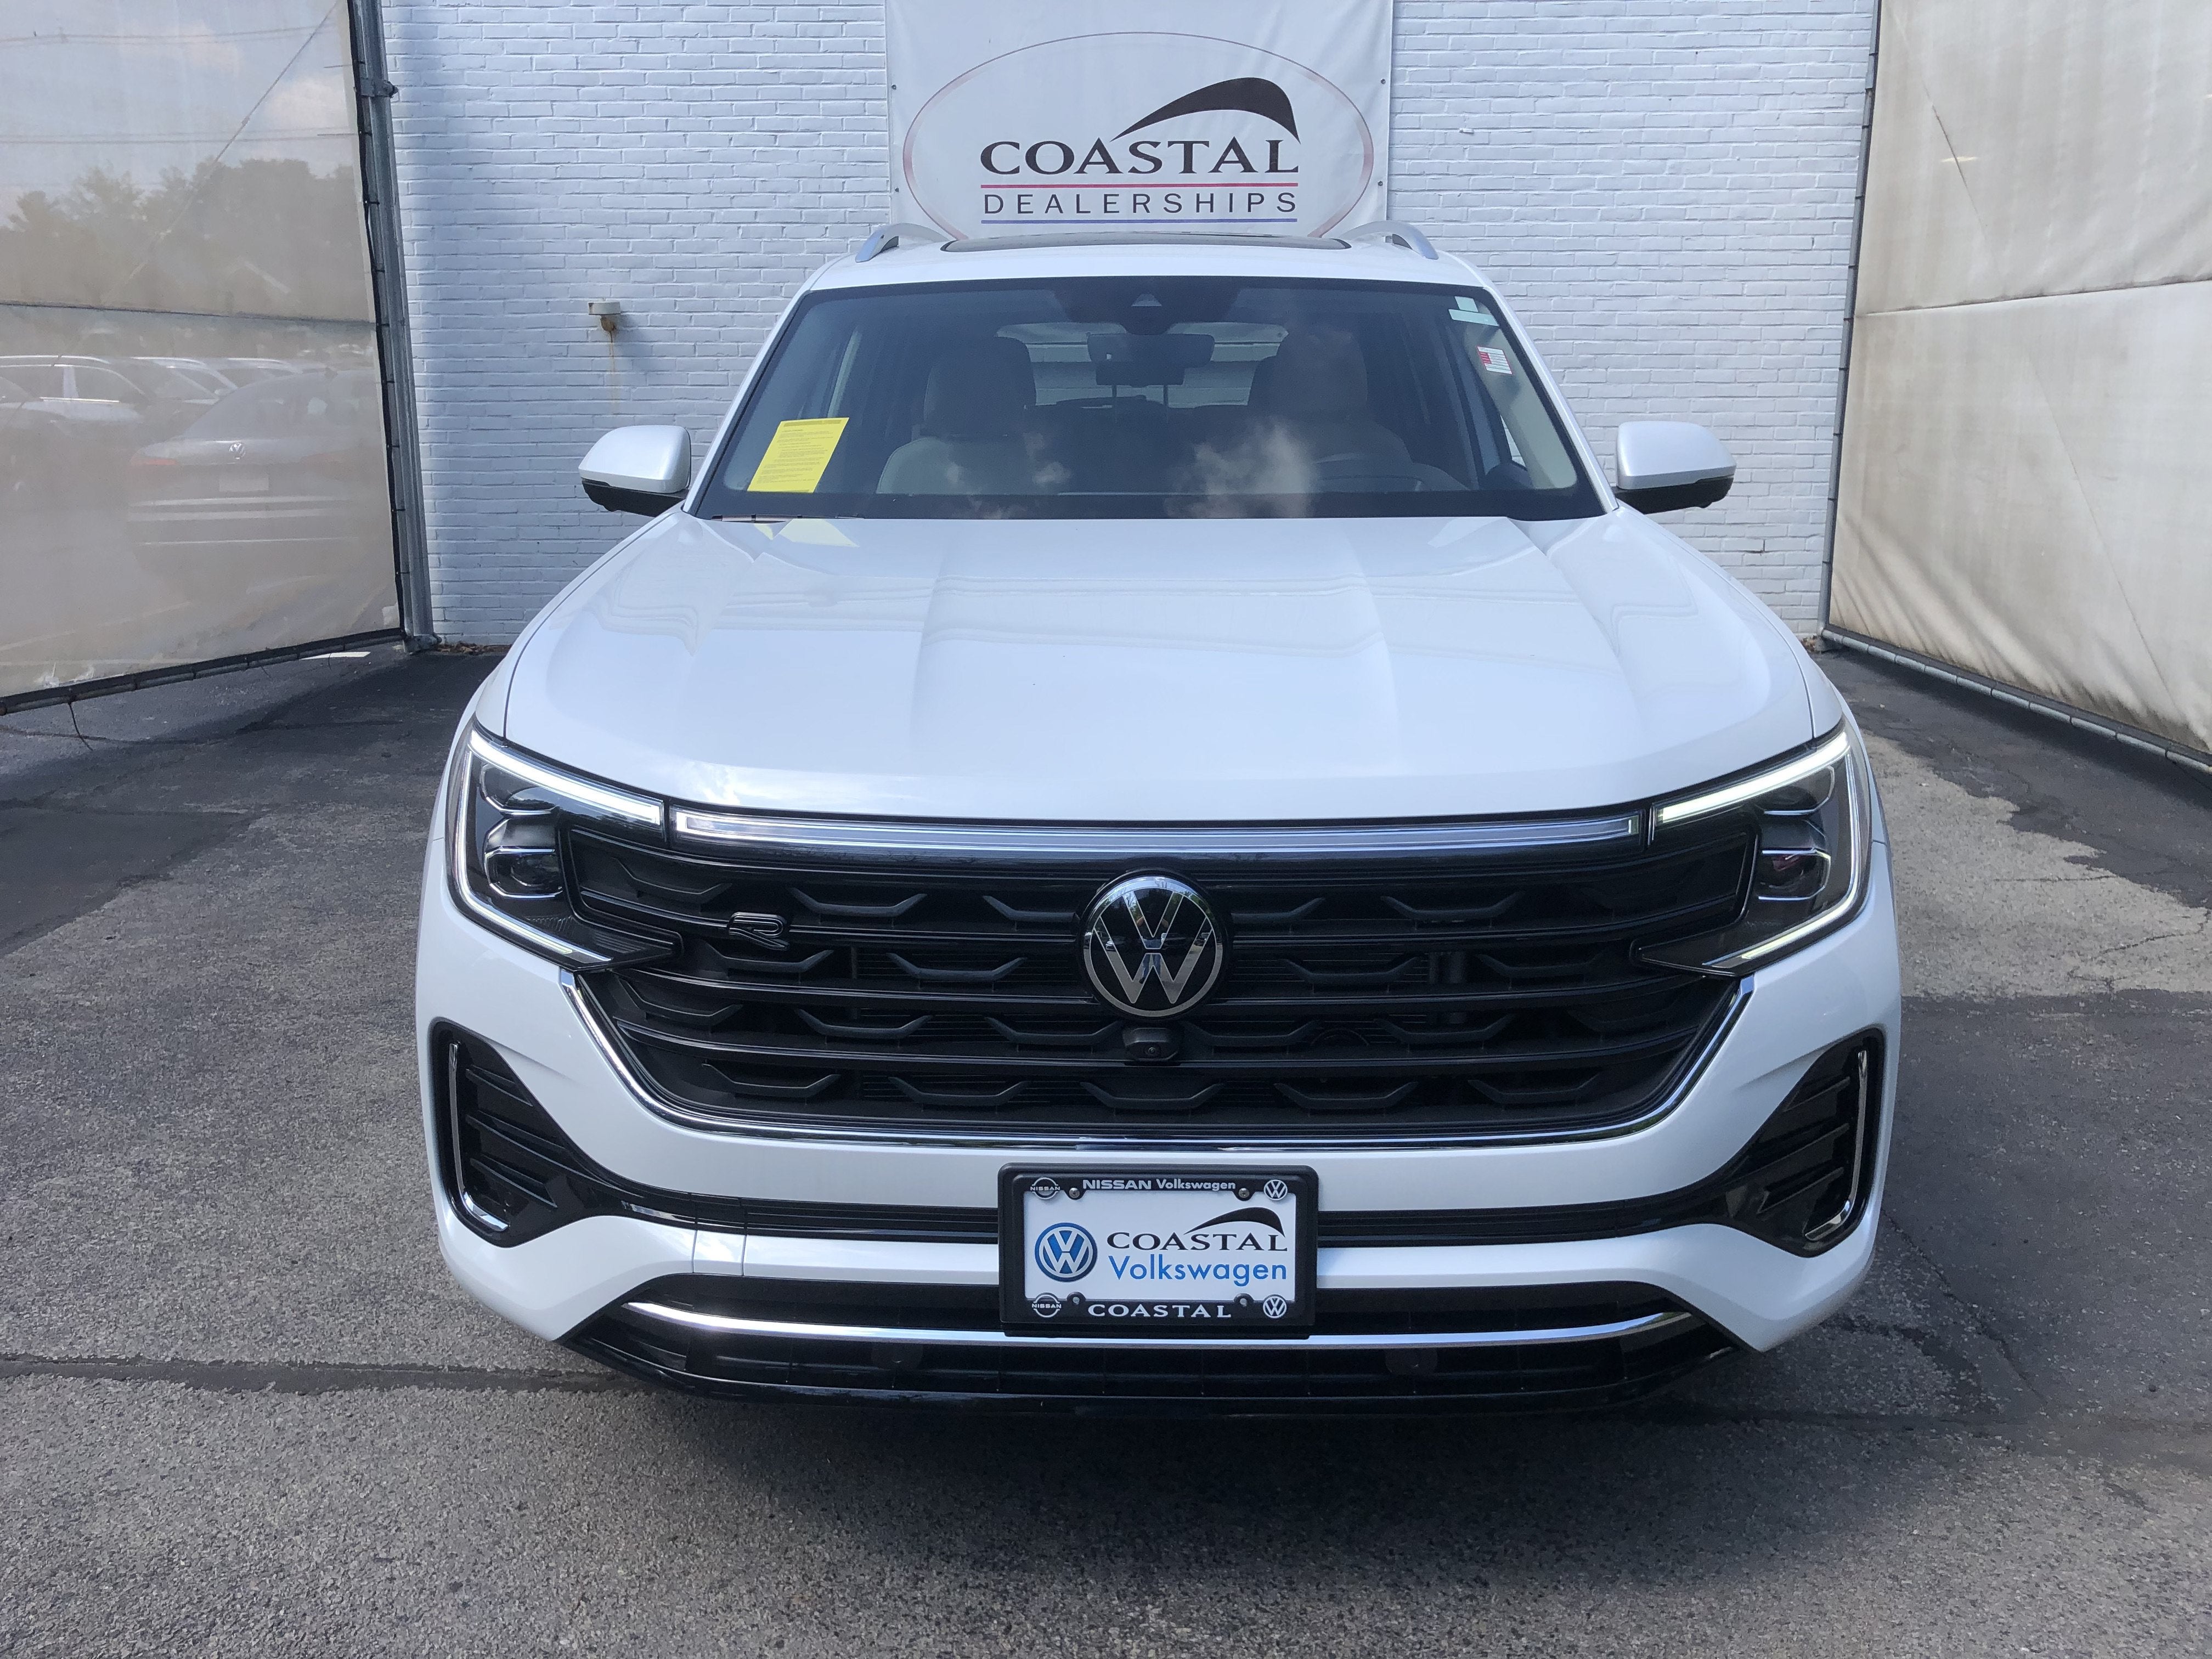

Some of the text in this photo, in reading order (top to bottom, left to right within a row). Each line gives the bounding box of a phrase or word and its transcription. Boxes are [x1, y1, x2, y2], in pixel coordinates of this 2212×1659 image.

[980, 136, 1300, 175] COASTAL
[984, 192, 1296, 215] DEALERSHIPS
[1093, 890, 1214, 1004] VW
[1082, 1178, 1236, 1191] NISSAN Volkswagen
[1263, 1180, 1288, 1200] VW
[1040, 1227, 1093, 1277] VW
[1107, 1232, 1288, 1251] COASTAL
[1108, 1254, 1286, 1286] Volkswagen
[1088, 1304, 1232, 1318] COASTAL
[1263, 1294, 1287, 1318] VW
